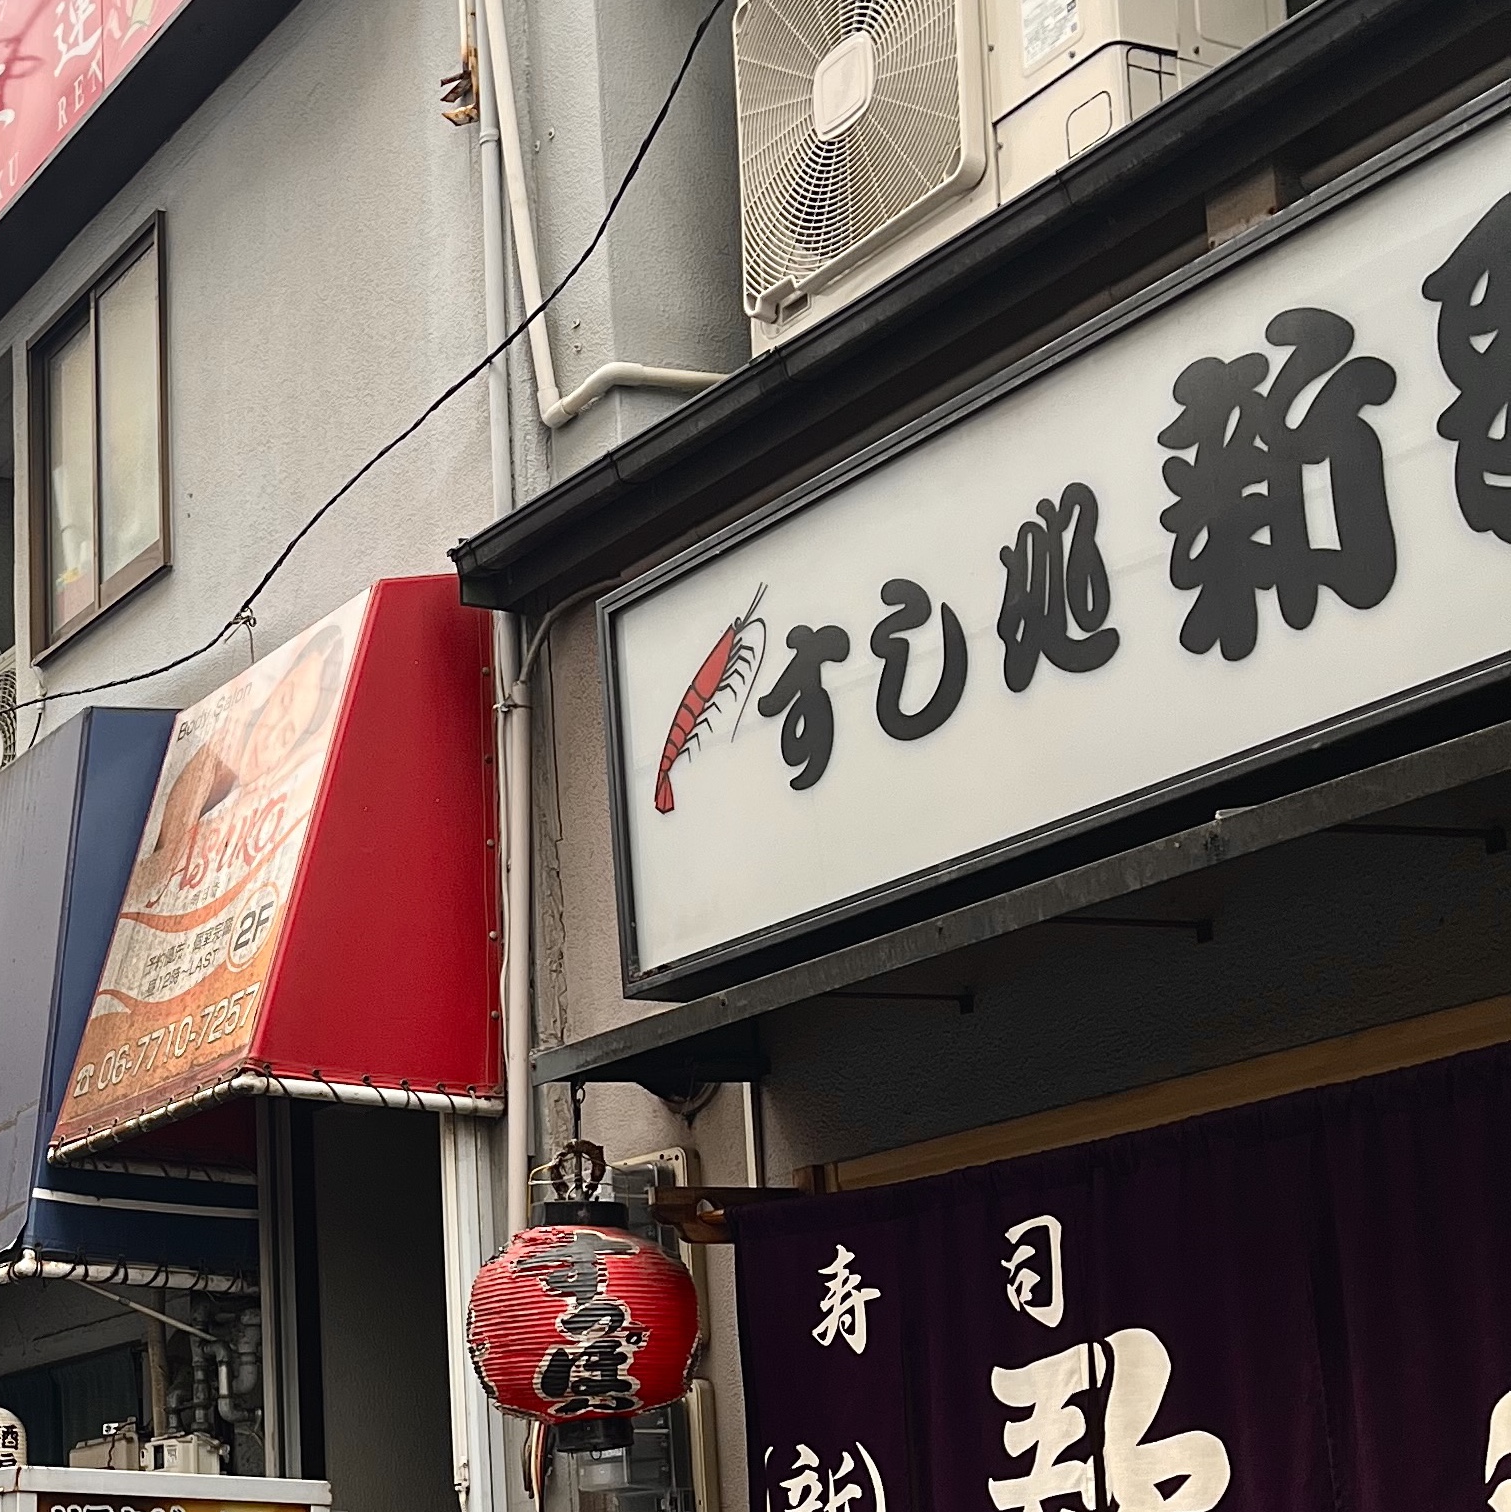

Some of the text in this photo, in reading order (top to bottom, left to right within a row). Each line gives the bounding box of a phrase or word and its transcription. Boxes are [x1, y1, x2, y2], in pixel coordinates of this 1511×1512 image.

[177, 680, 253, 742] Body Salon
[233, 901, 275, 952] 2F
[97, 982, 261, 1090] 06-7710-7257
